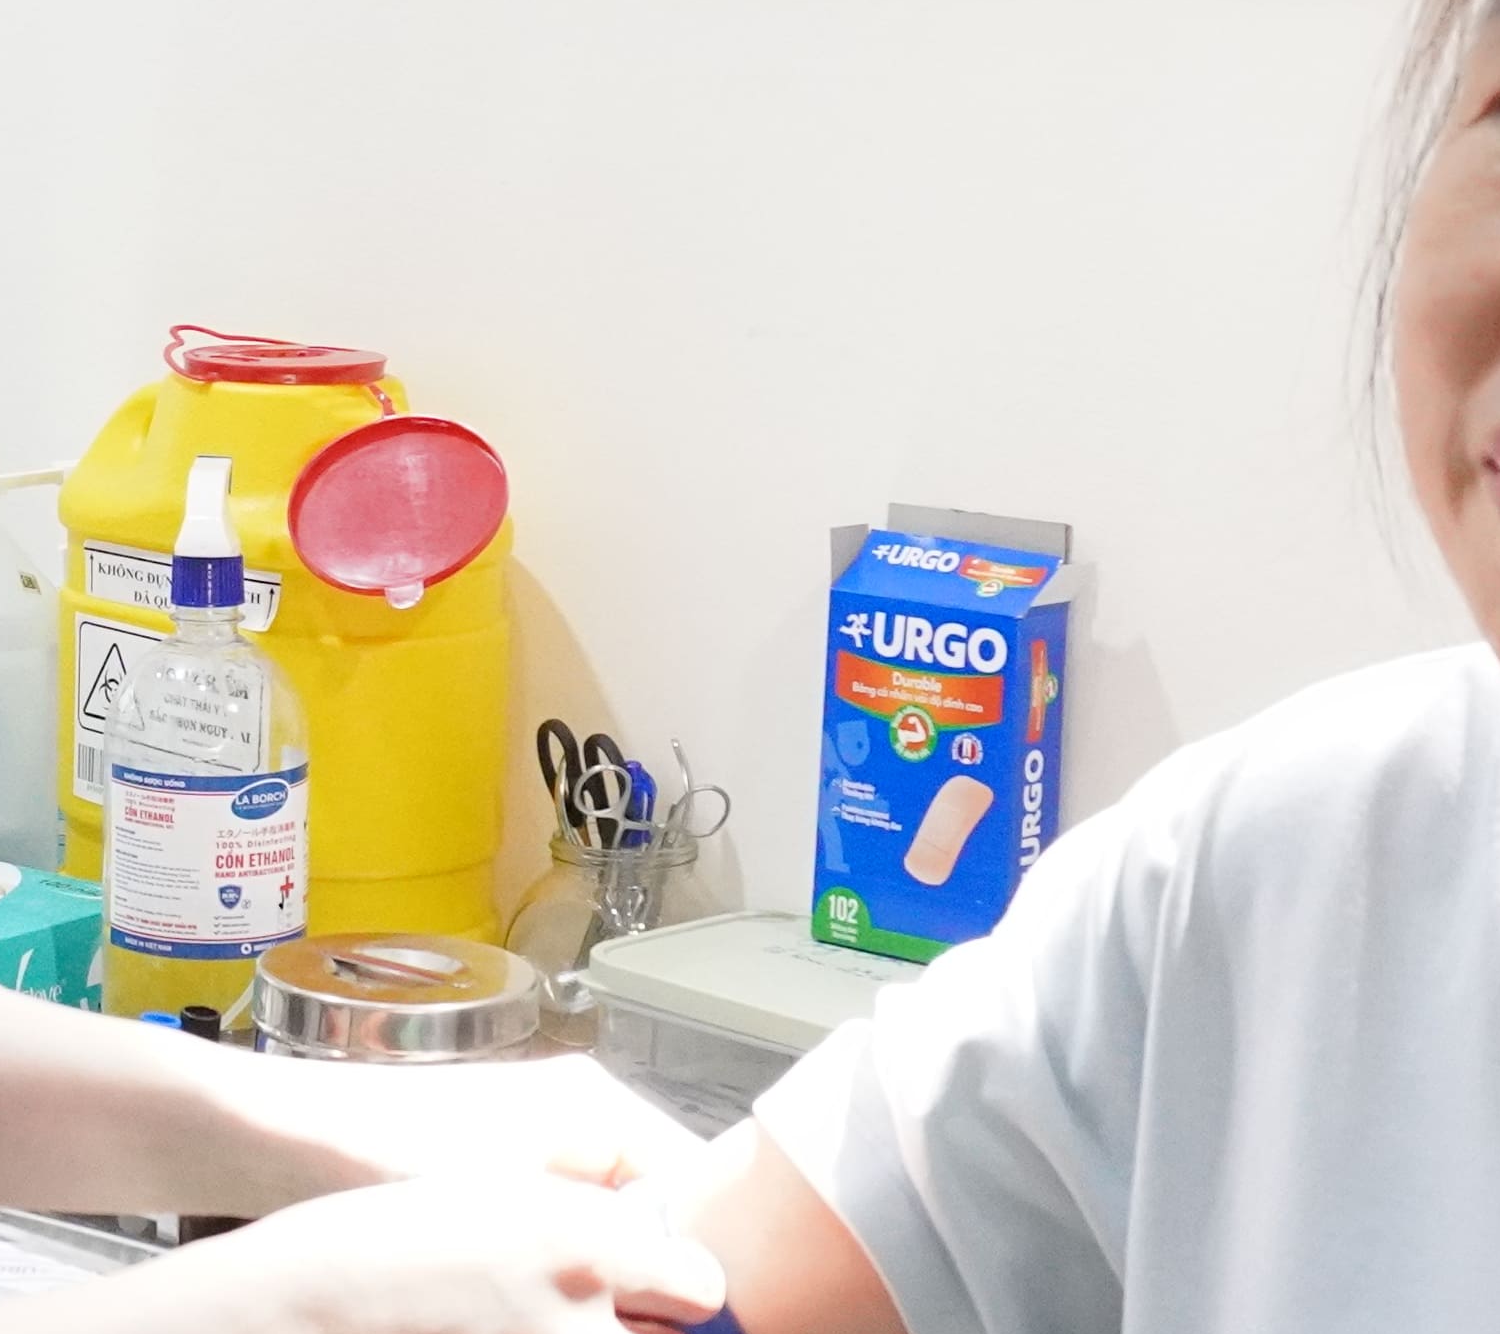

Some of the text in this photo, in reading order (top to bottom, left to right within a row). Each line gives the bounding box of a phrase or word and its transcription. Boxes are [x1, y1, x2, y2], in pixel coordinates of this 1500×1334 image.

[888, 545, 960, 573] URGO
[98, 562, 144, 582] KHÔNG
[872, 611, 1008, 673] URGO
[892, 671, 942, 693] Durable
[236, 791, 286, 805] LA BORCH
[1019, 749, 1044, 867] URGO
[140, 809, 175, 823] ETHANOL
[216, 847, 295, 869] CỒN ETHANOL
[828, 894, 858, 924] 102
